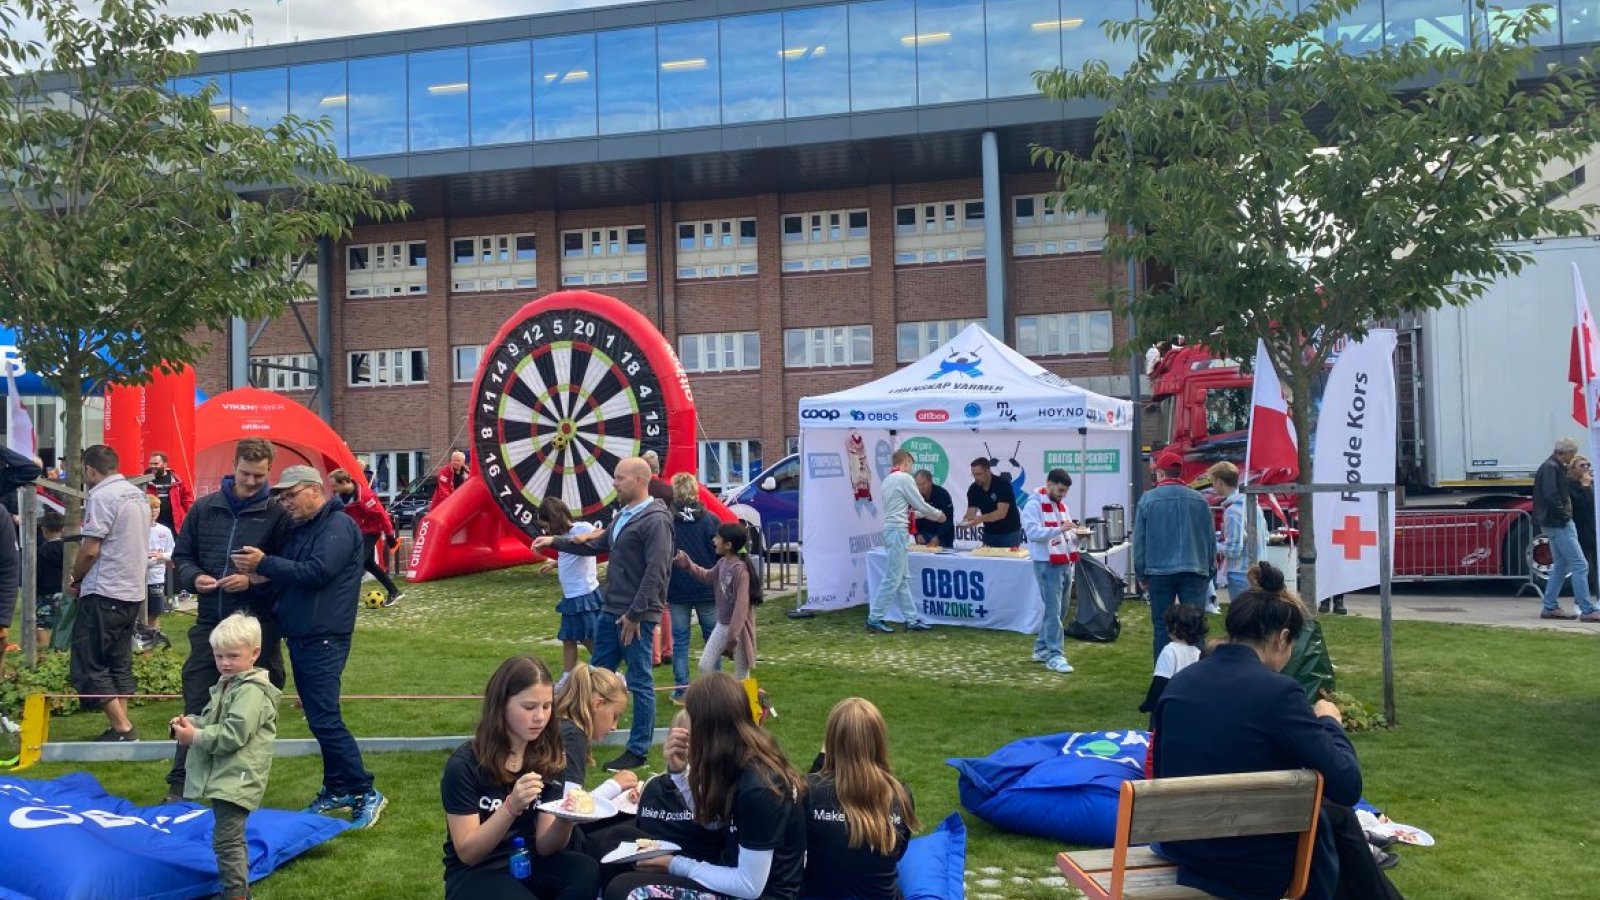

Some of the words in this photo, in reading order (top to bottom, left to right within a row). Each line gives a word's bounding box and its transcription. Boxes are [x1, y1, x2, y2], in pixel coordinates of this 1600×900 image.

[523, 325, 544, 344] 12
[553, 320, 563, 335] 5
[573, 319, 596, 337] 20
[606, 334, 615, 349] 1
[507, 343, 519, 357] 9
[491, 360, 508, 383] 14
[621, 351, 640, 376] 18
[640, 385, 653, 398] 4
[482, 390, 497, 413] 11
[1346, 372, 1369, 429] Kors
[801, 409, 841, 421] coop
[867, 412, 898, 421] OBOS
[1038, 407, 1084, 418] HOY.NO
[645, 410, 660, 437] 13
[481, 426, 493, 439] 8
[485, 452, 501, 478] 16
[499, 485, 512, 498] 7
[513, 503, 533, 524] 19
[411, 520, 430, 568] altibox
[921, 567, 985, 601] OBOS
[665, 809, 694, 822] possib
[814, 809, 845, 822] Make
